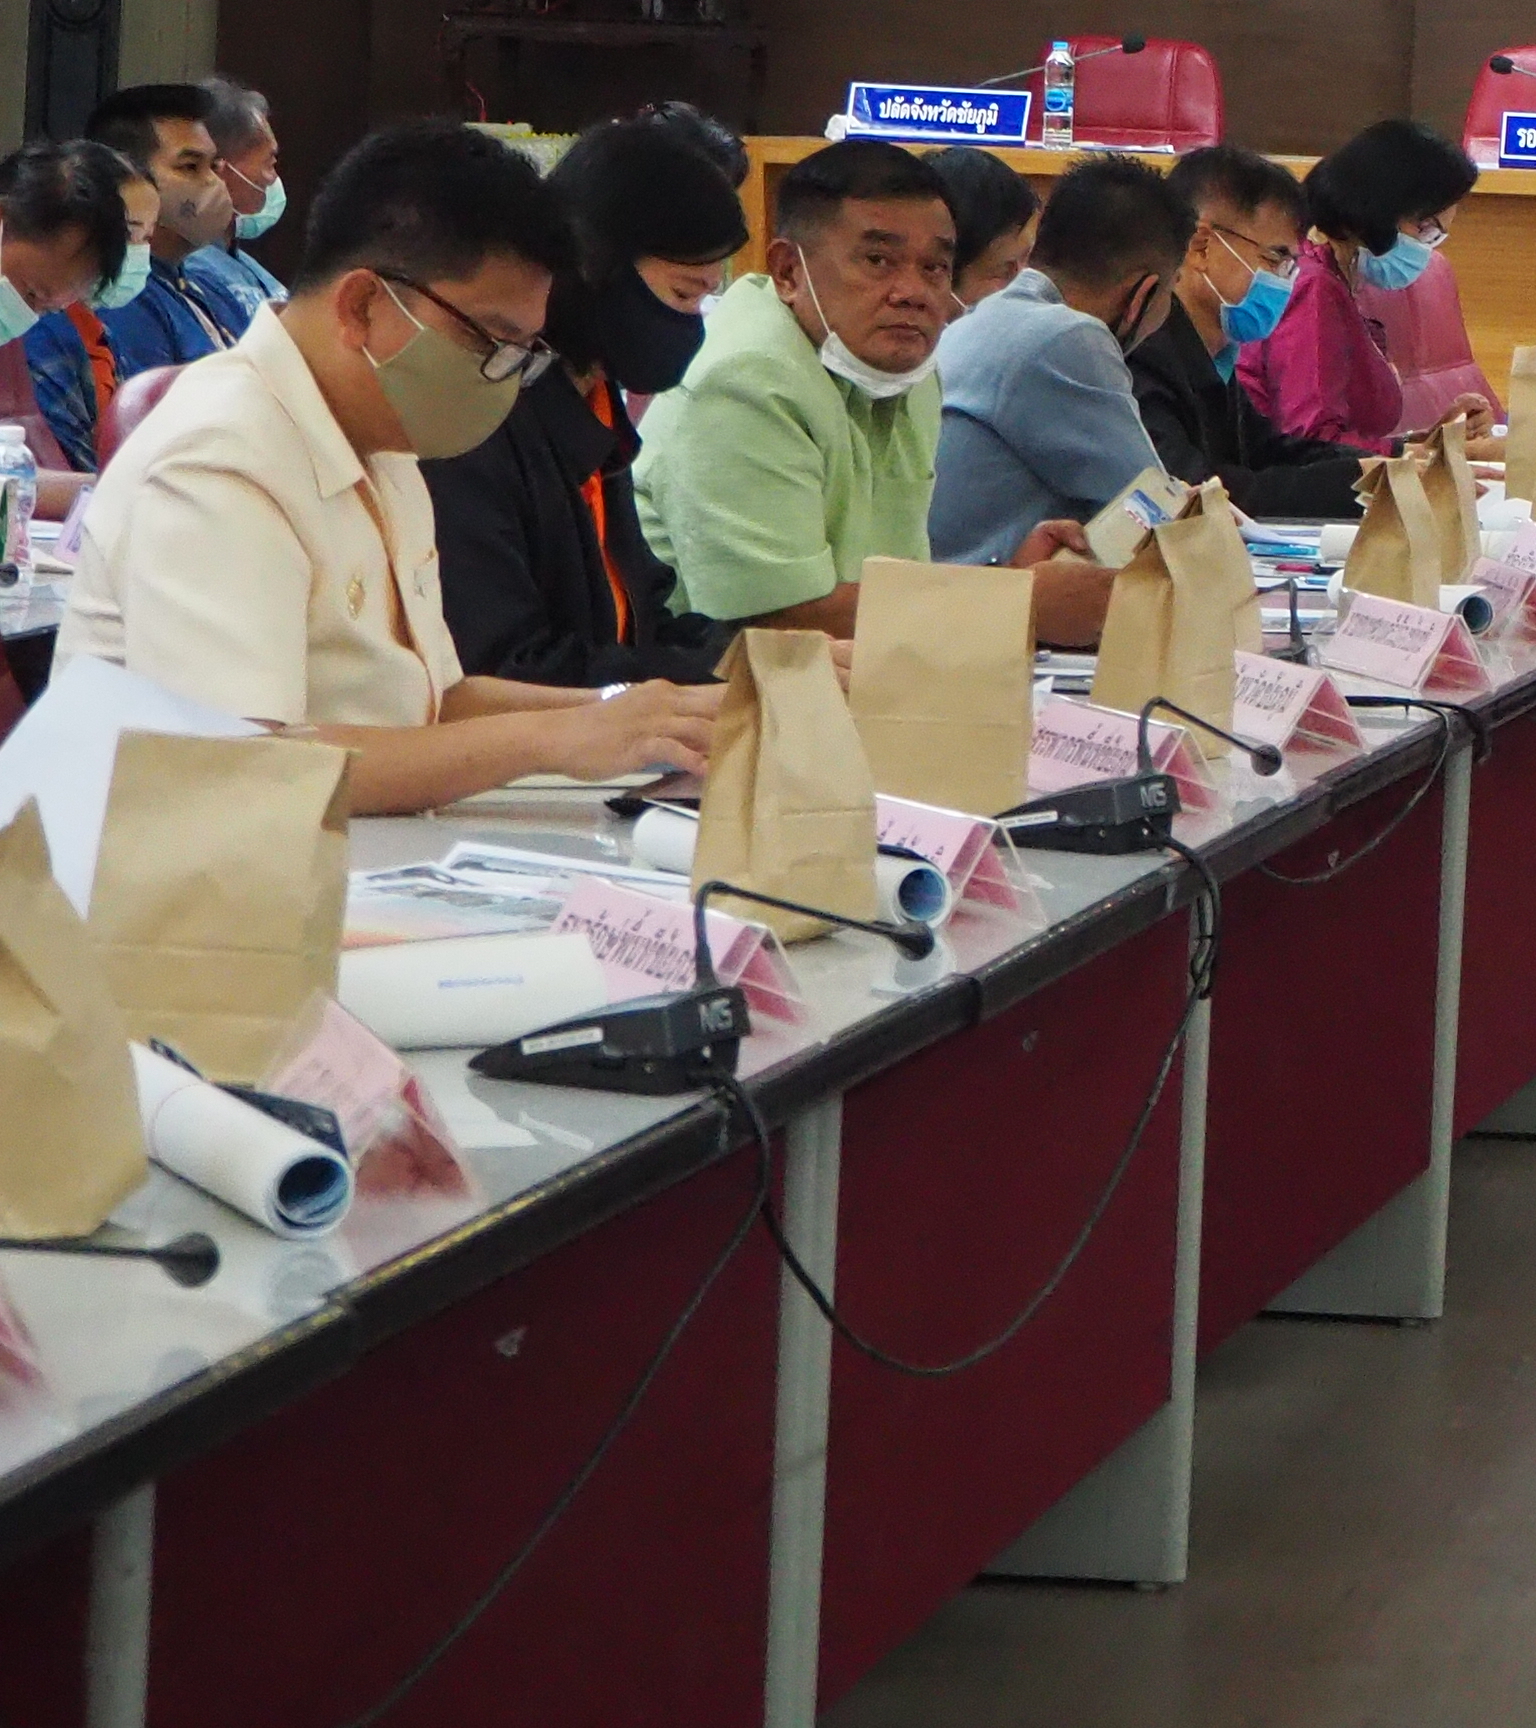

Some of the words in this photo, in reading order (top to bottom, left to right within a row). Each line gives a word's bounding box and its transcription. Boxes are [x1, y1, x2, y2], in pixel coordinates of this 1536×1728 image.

[878, 95, 999, 134] ปลัดจังหวัดชัยภูมิ
